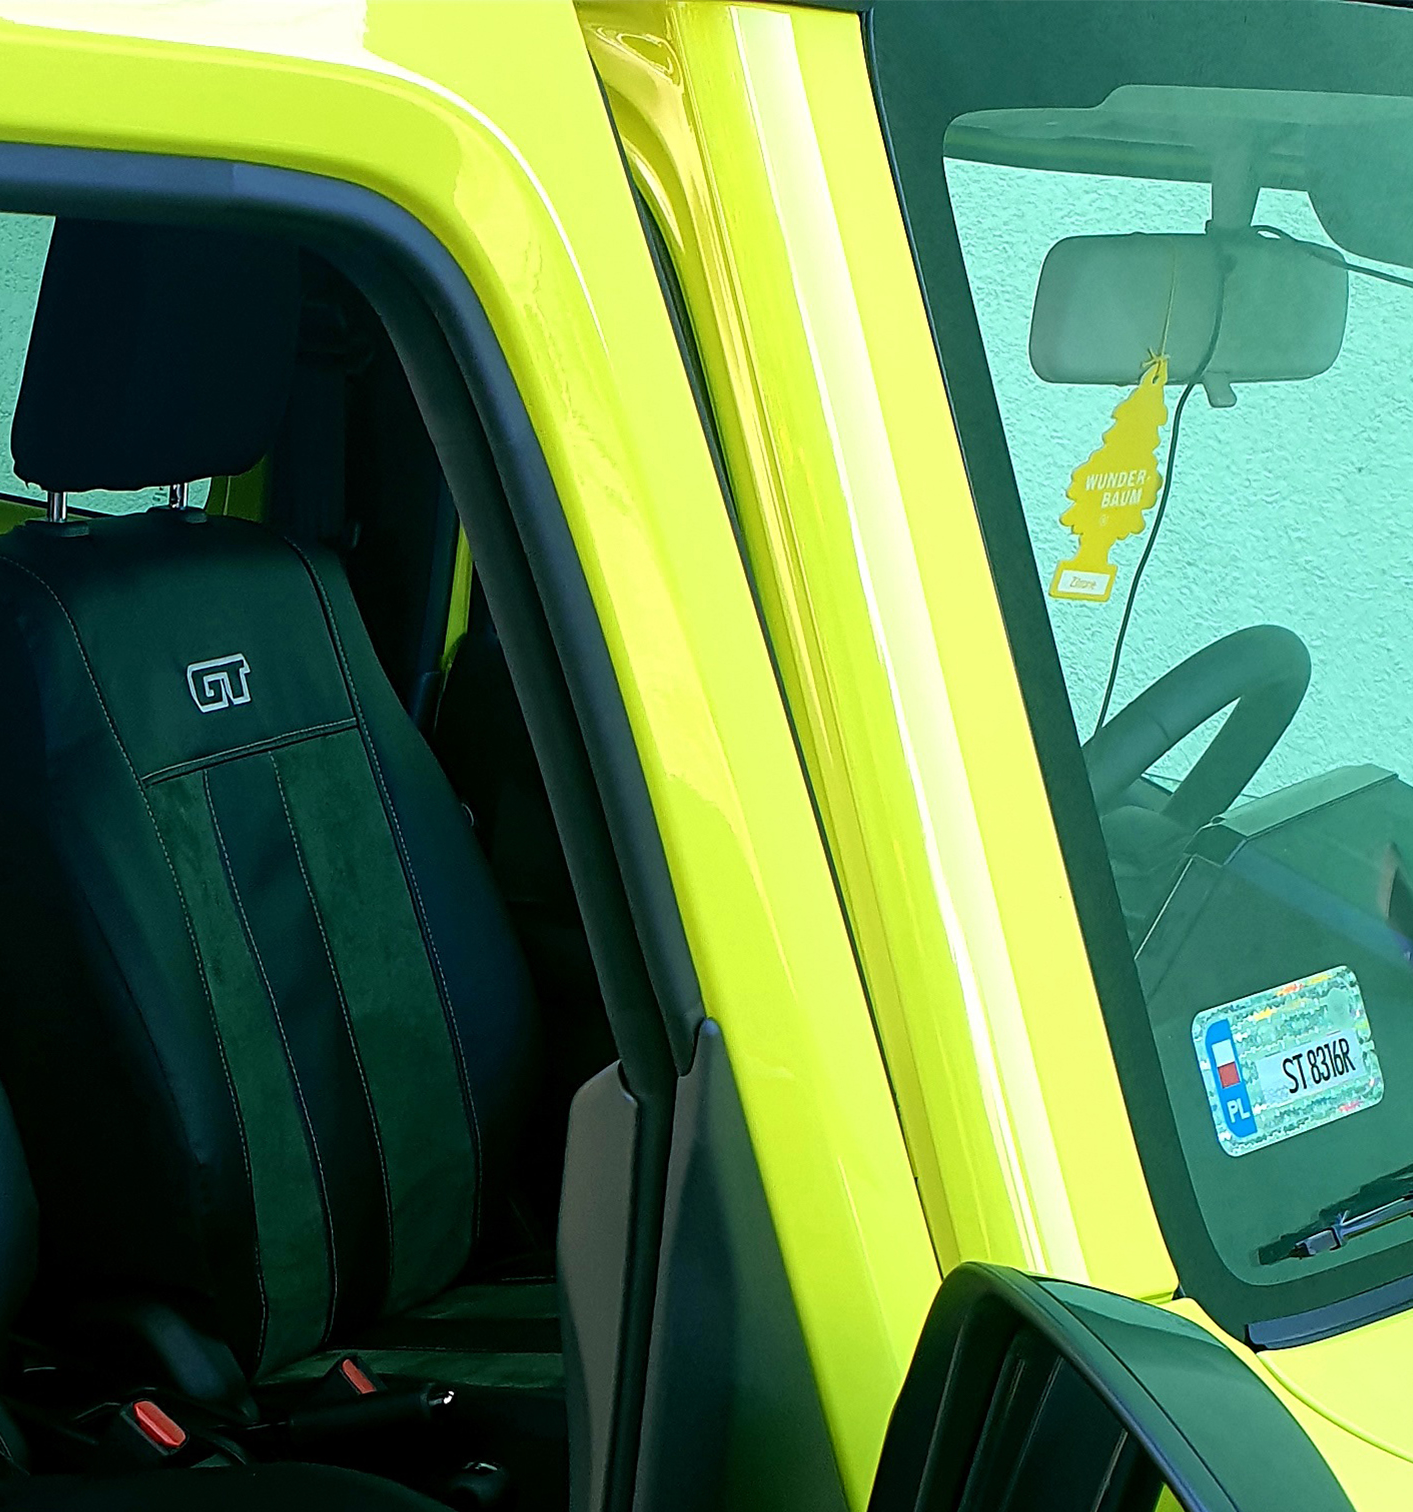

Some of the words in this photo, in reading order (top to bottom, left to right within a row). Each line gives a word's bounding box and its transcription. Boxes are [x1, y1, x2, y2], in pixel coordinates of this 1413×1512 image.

[1086, 470, 1150, 491] WUNDER-
[1101, 488, 1142, 508] BAUM
[186, 652, 251, 713] GT
[1282, 1053, 1308, 1094] ST
[1306, 1037, 1356, 1085] 8316R
[1226, 1097, 1250, 1124] PL
